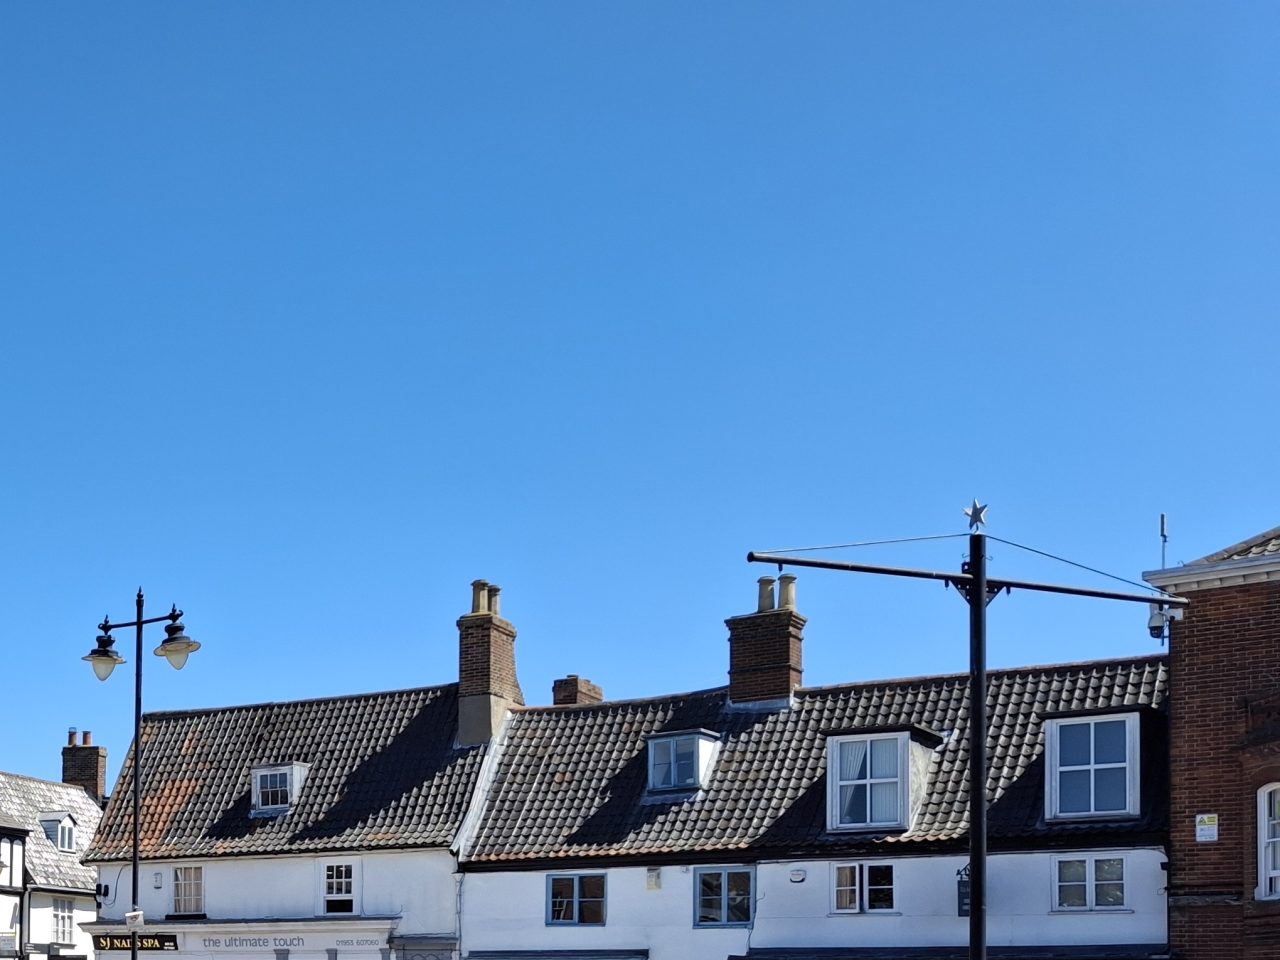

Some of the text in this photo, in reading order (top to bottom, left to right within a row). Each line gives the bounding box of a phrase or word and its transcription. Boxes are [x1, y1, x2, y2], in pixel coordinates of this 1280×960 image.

[100, 937, 111, 950] SJ
[113, 939, 141, 948] NAIS
[142, 938, 160, 948] SPA
[203, 936, 305, 948] the ultimate touch
